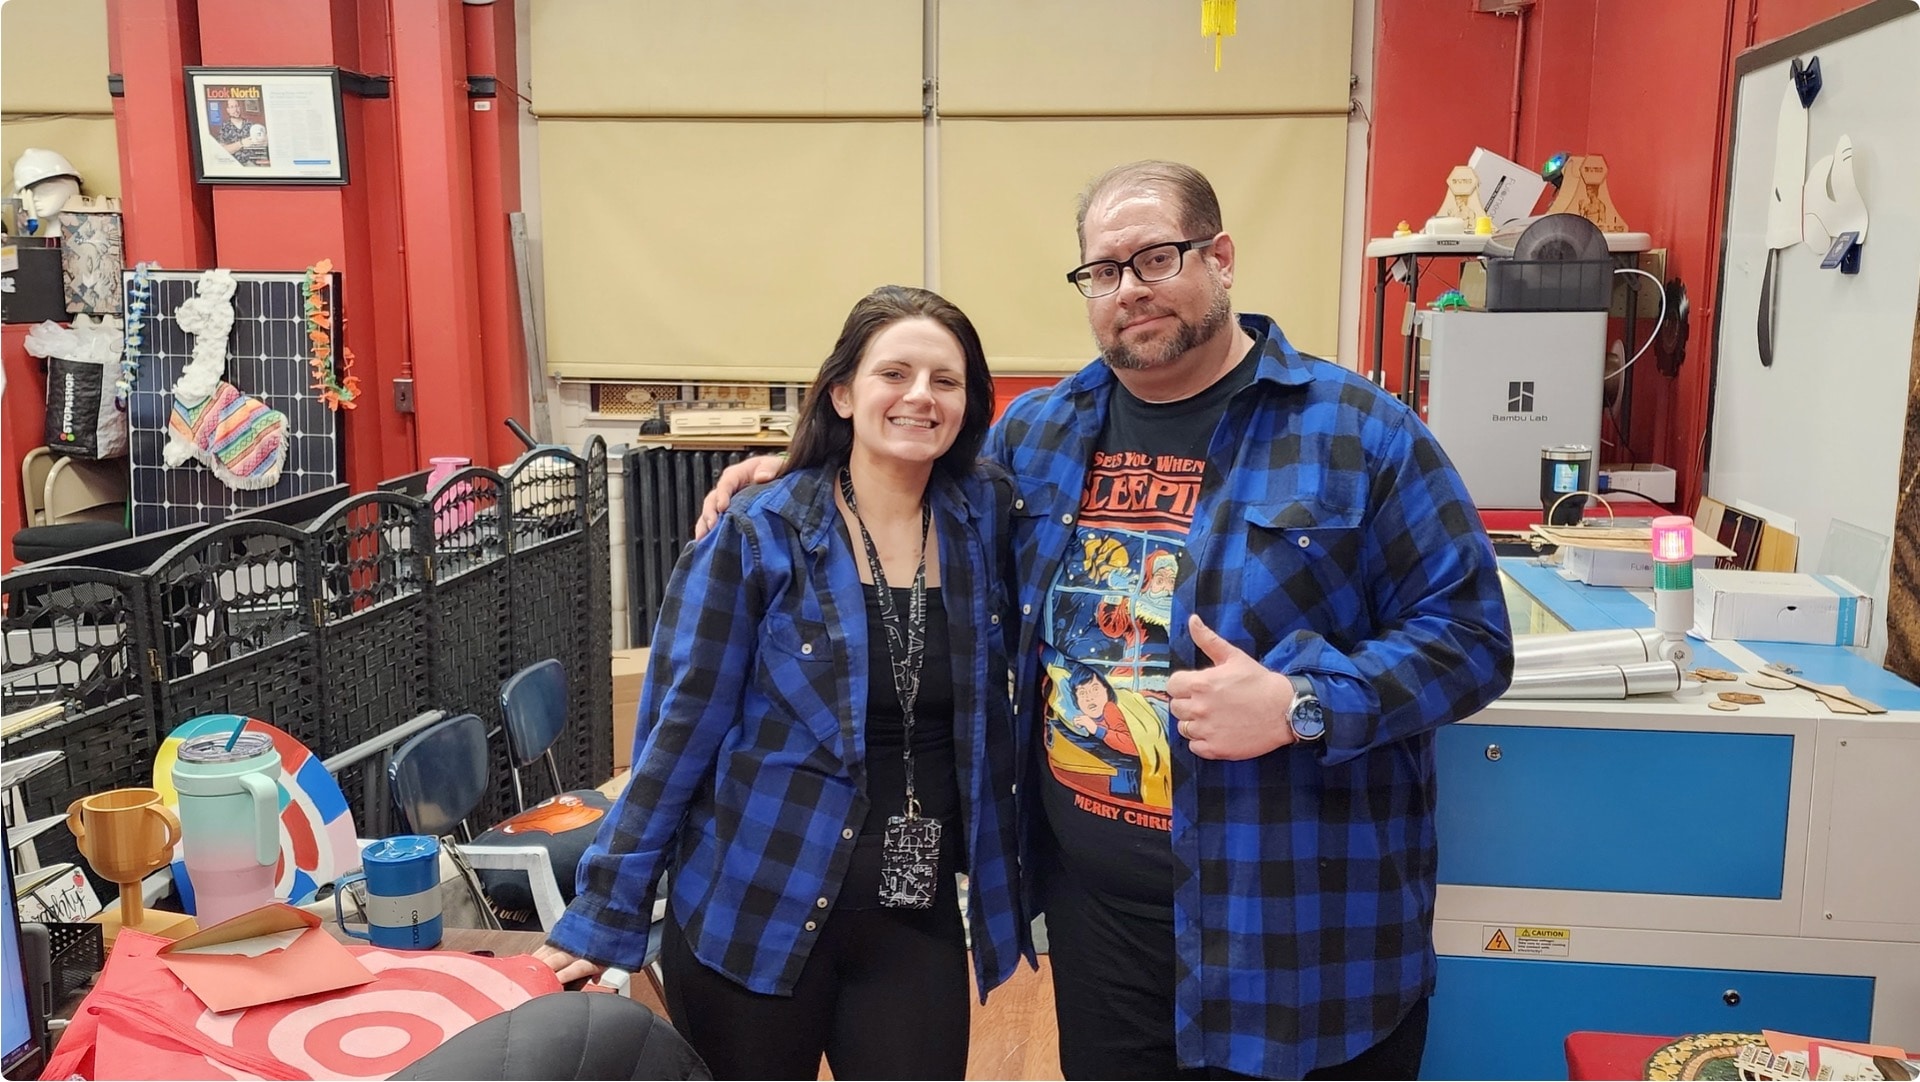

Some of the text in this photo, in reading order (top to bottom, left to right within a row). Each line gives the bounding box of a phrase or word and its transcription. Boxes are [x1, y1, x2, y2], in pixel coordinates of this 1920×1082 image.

[207, 87, 230, 98] Look
[231, 87, 260, 98] North
[1094, 452, 1206, 473] SEES YOU WHEN
[1074, 794, 1121, 820] MERRY
[1532, 929, 1564, 937] CAUTION
